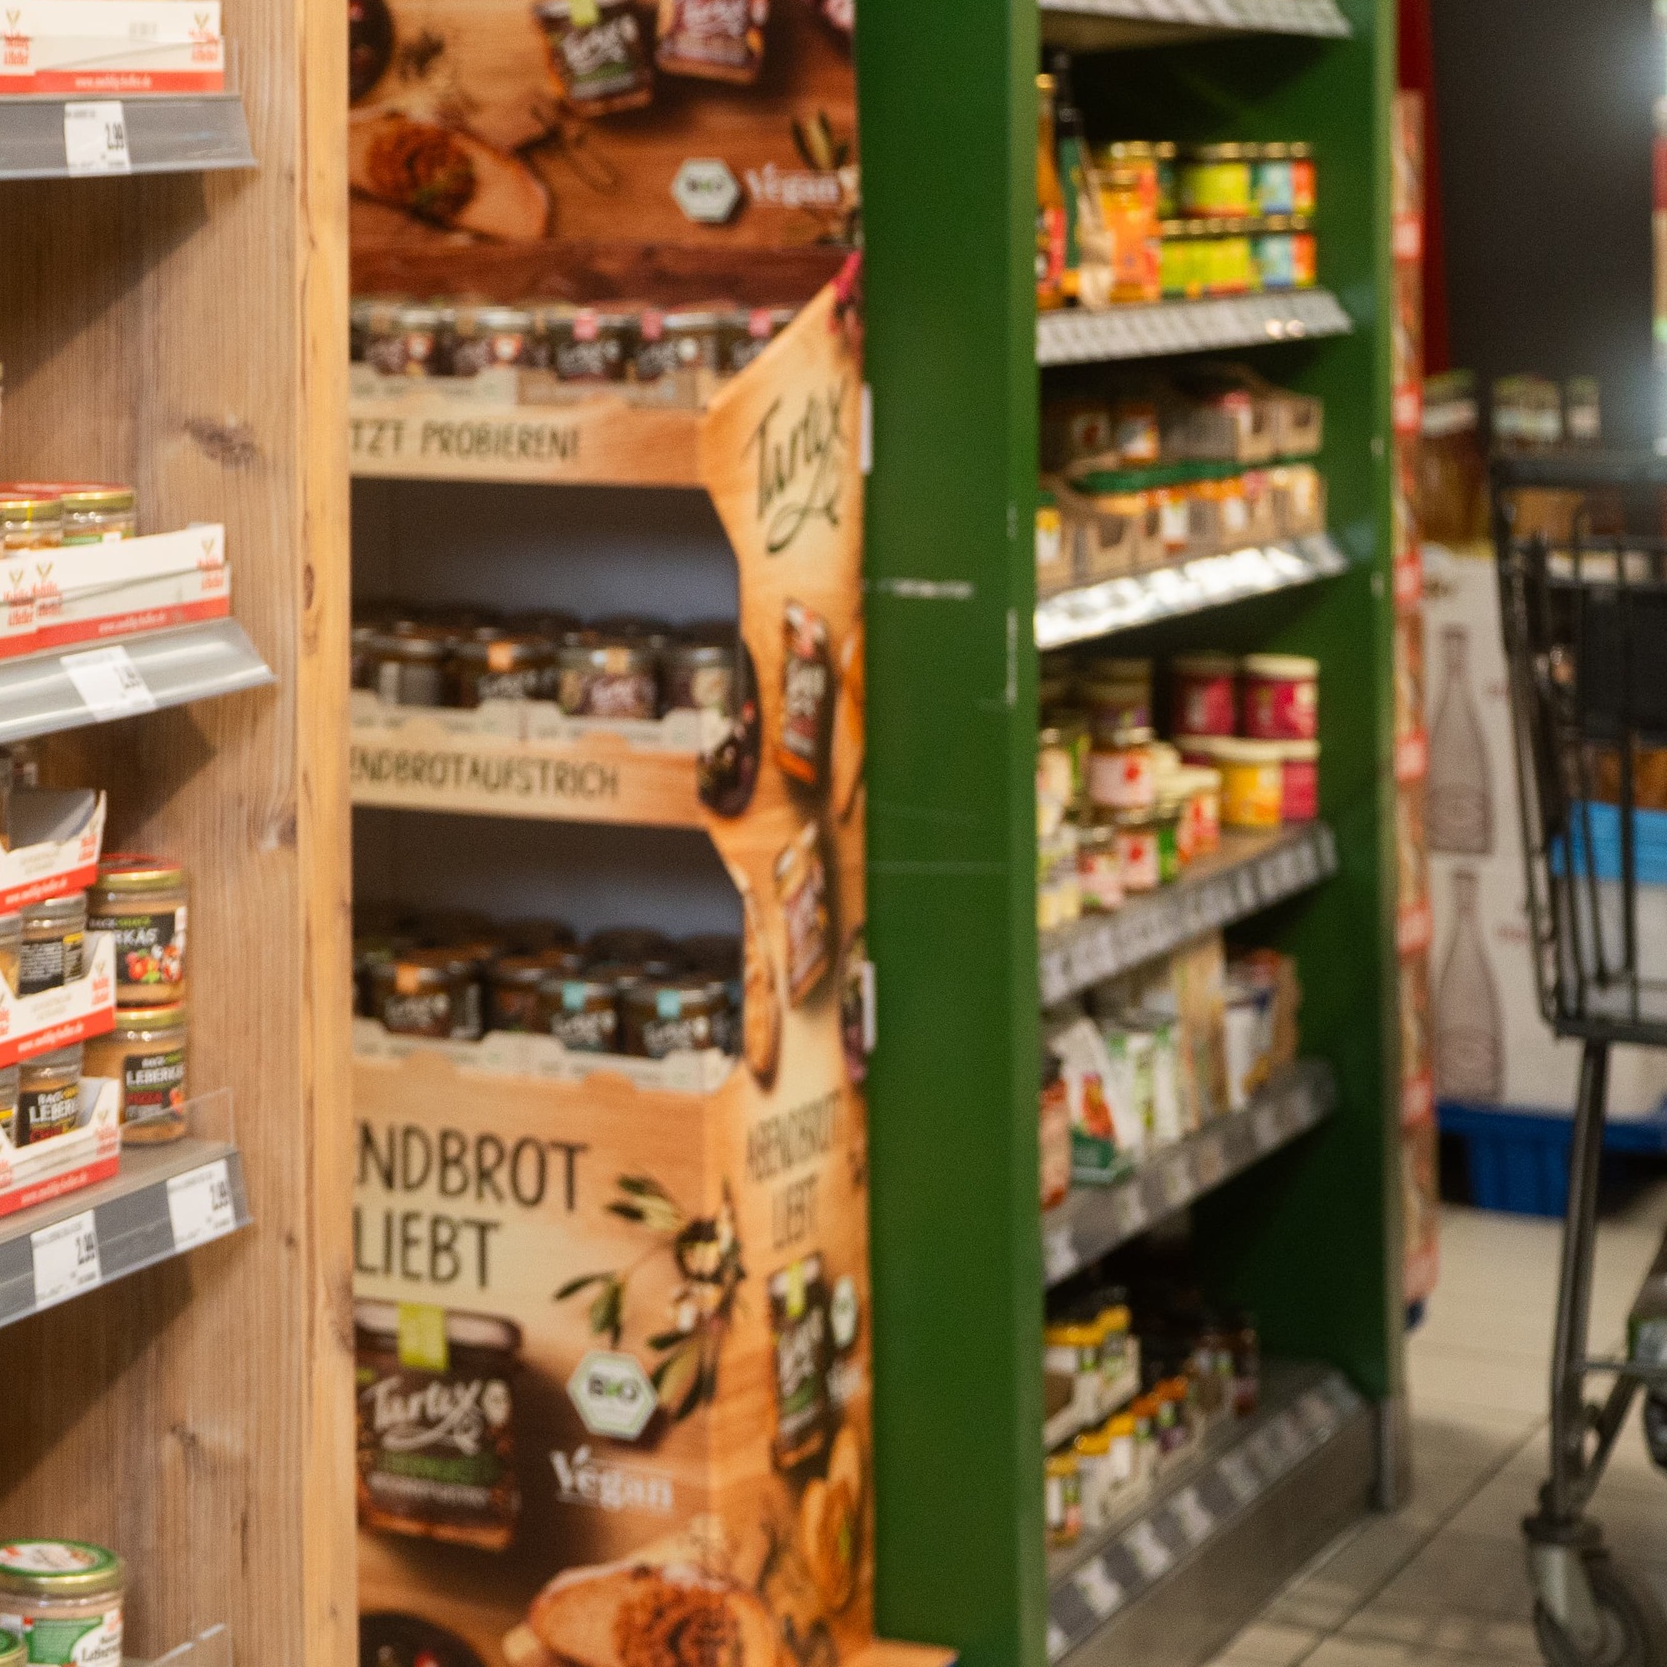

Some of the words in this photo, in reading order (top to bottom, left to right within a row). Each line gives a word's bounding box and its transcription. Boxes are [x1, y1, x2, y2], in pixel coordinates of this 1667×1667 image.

[420, 418, 581, 463] PROBIEREN!
[352, 1205, 500, 1290] LIEBT
[550, 1445, 675, 1510] Vegan
